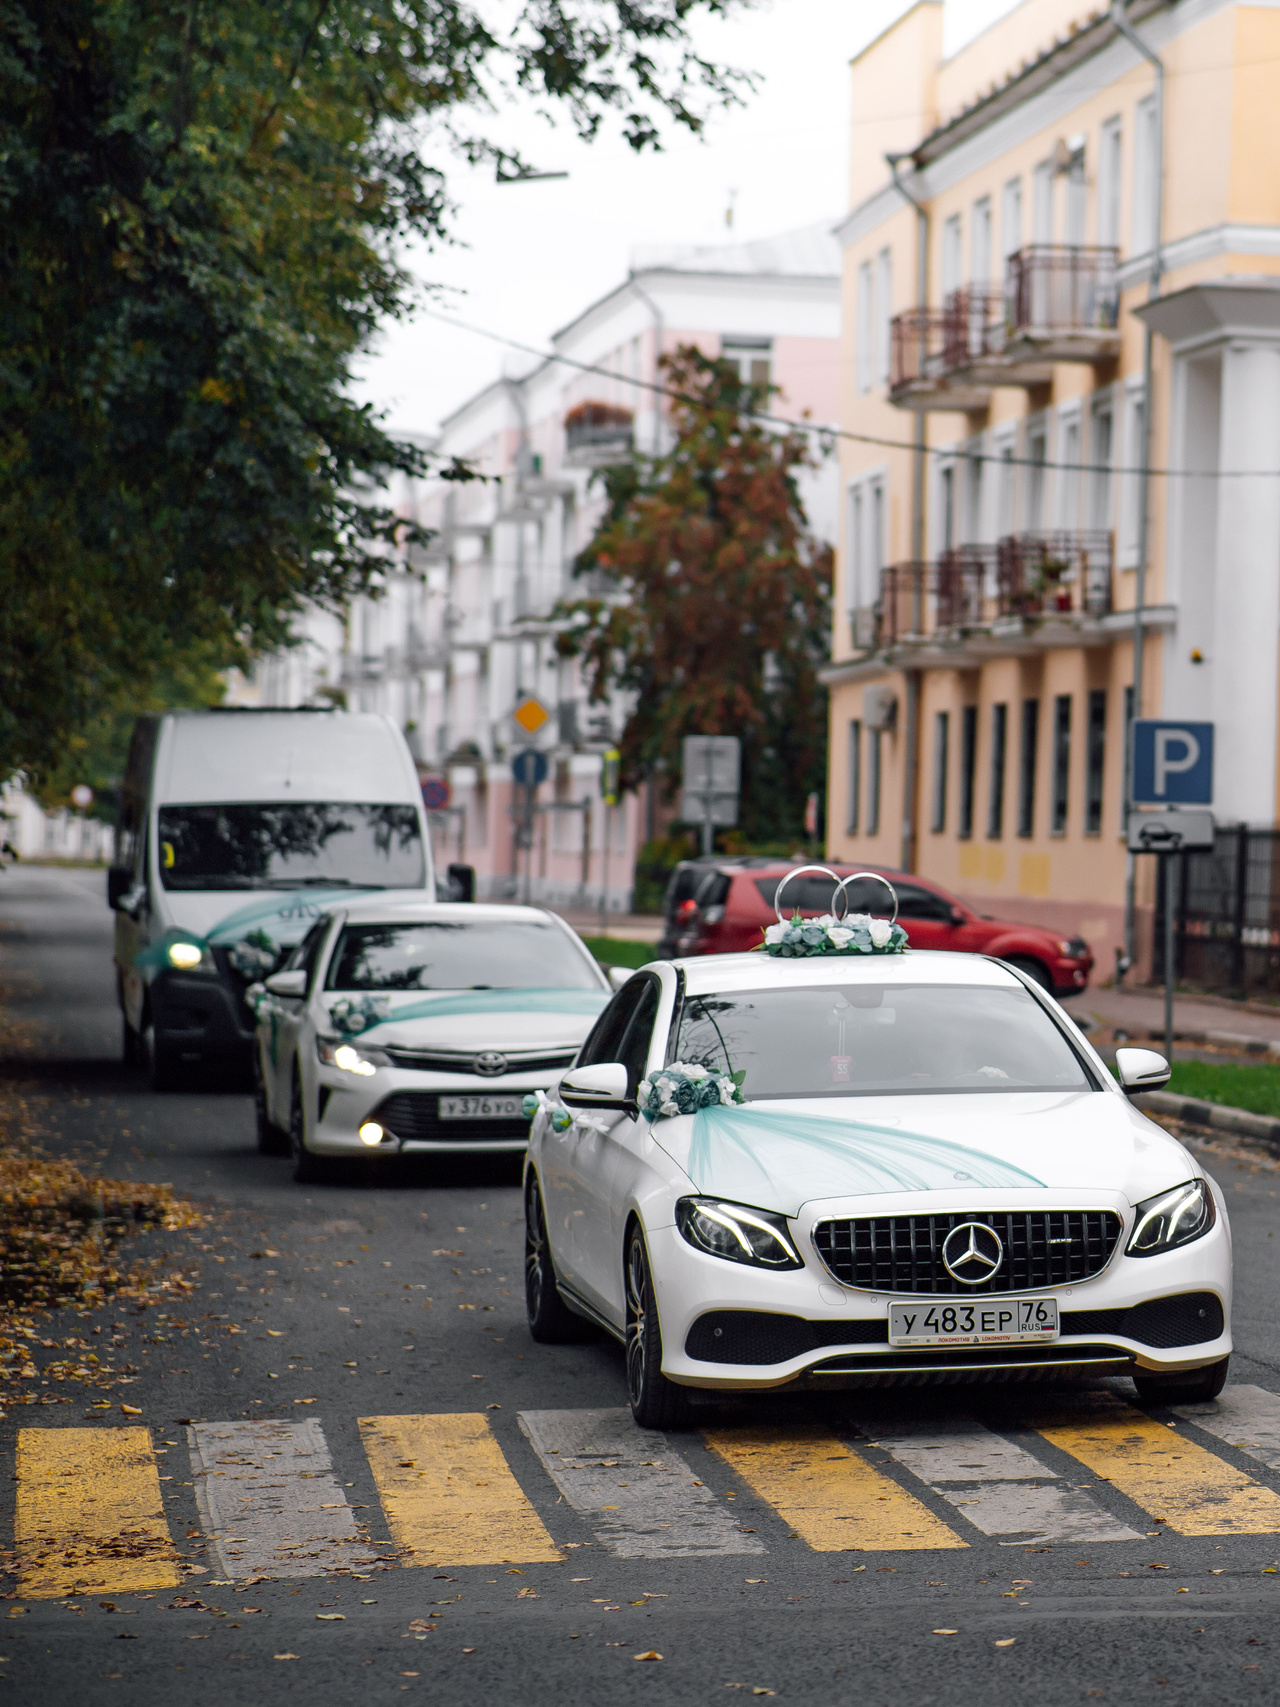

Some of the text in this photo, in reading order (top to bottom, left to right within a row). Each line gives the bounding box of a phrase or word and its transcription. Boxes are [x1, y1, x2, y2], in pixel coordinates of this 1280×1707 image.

[1153, 728, 1200, 796] P
[1022, 1301, 1048, 1323] 76
[1021, 1323, 1041, 1331] RUS
